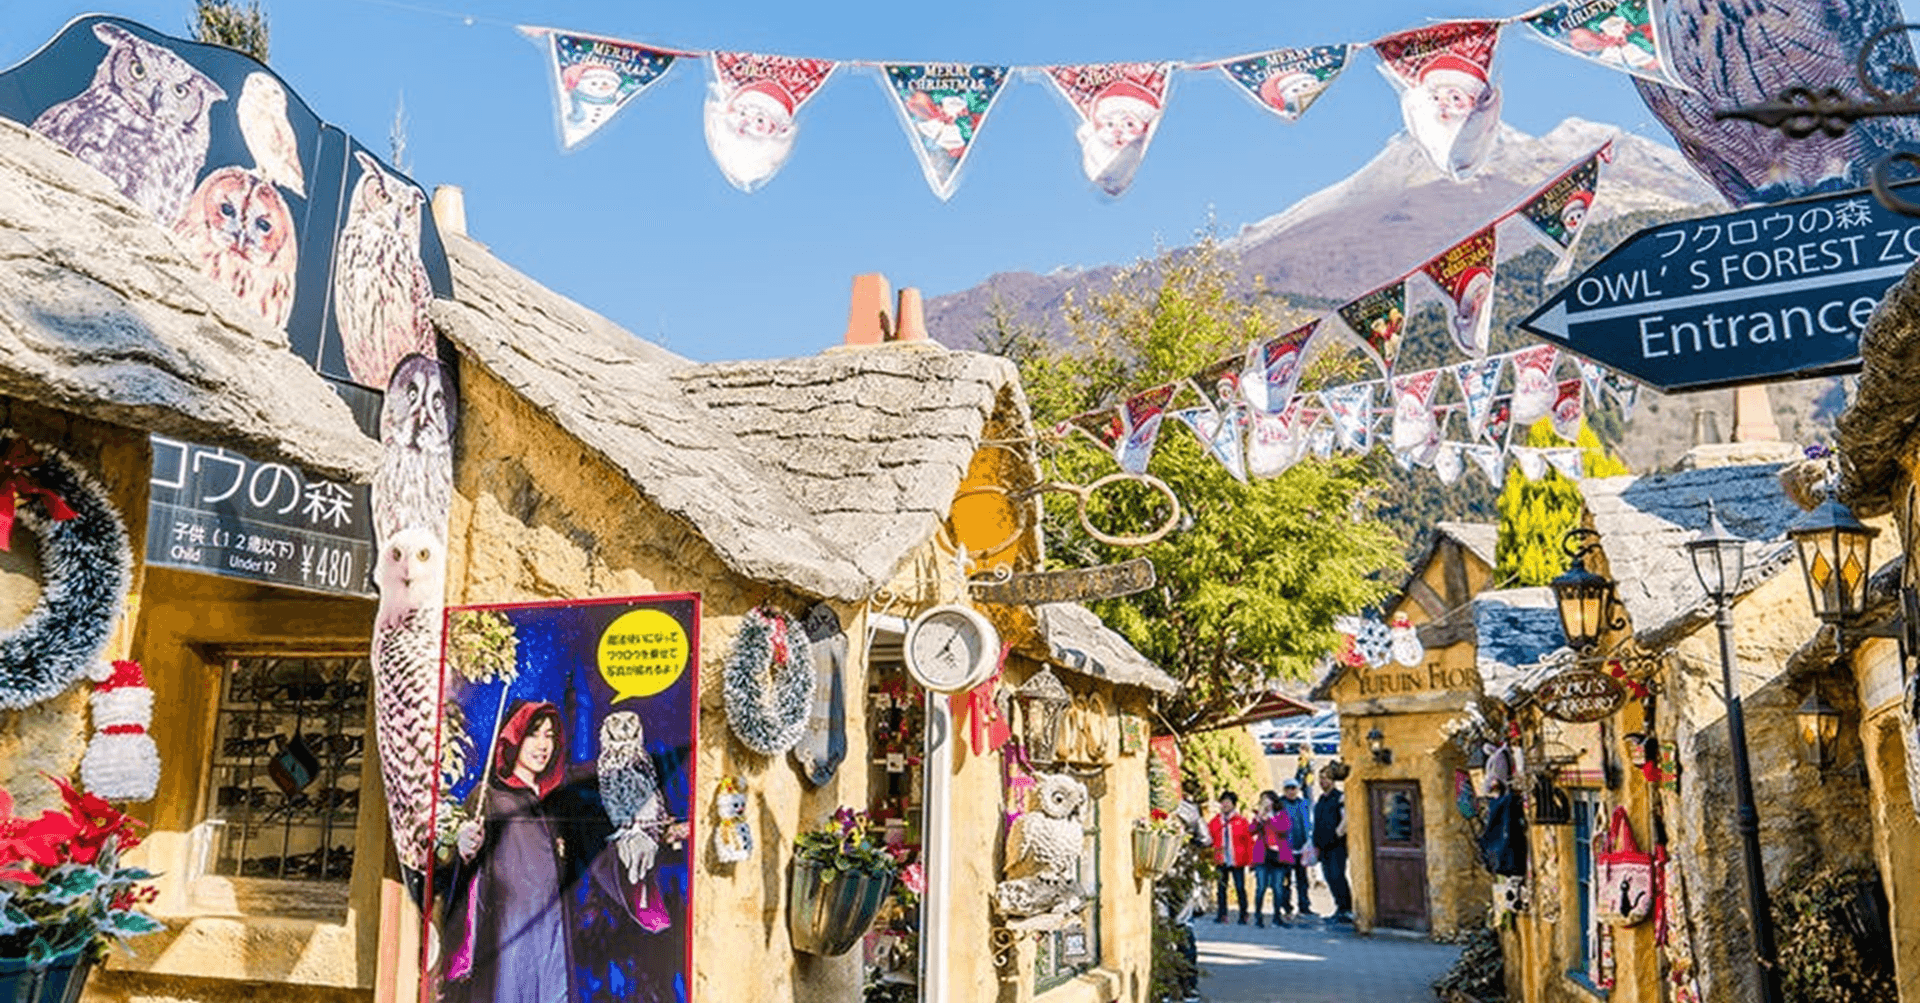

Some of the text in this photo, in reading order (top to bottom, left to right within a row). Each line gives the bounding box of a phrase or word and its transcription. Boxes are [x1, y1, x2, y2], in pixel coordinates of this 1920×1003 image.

[573, 52, 658, 77] CHRISTMAS
[593, 41, 640, 61] MERRY
[1265, 48, 1315, 64] MERRY
[925, 64, 973, 77] MERRY
[907, 77, 986, 92] CHRISTMAS
[1656, 199, 1873, 259] フクロウの森
[1721, 234, 1866, 286] FOREST
[1638, 297, 1879, 360] Entrance
[171, 545, 277, 574] Child Under 12
[301, 545, 352, 589] ¥480
